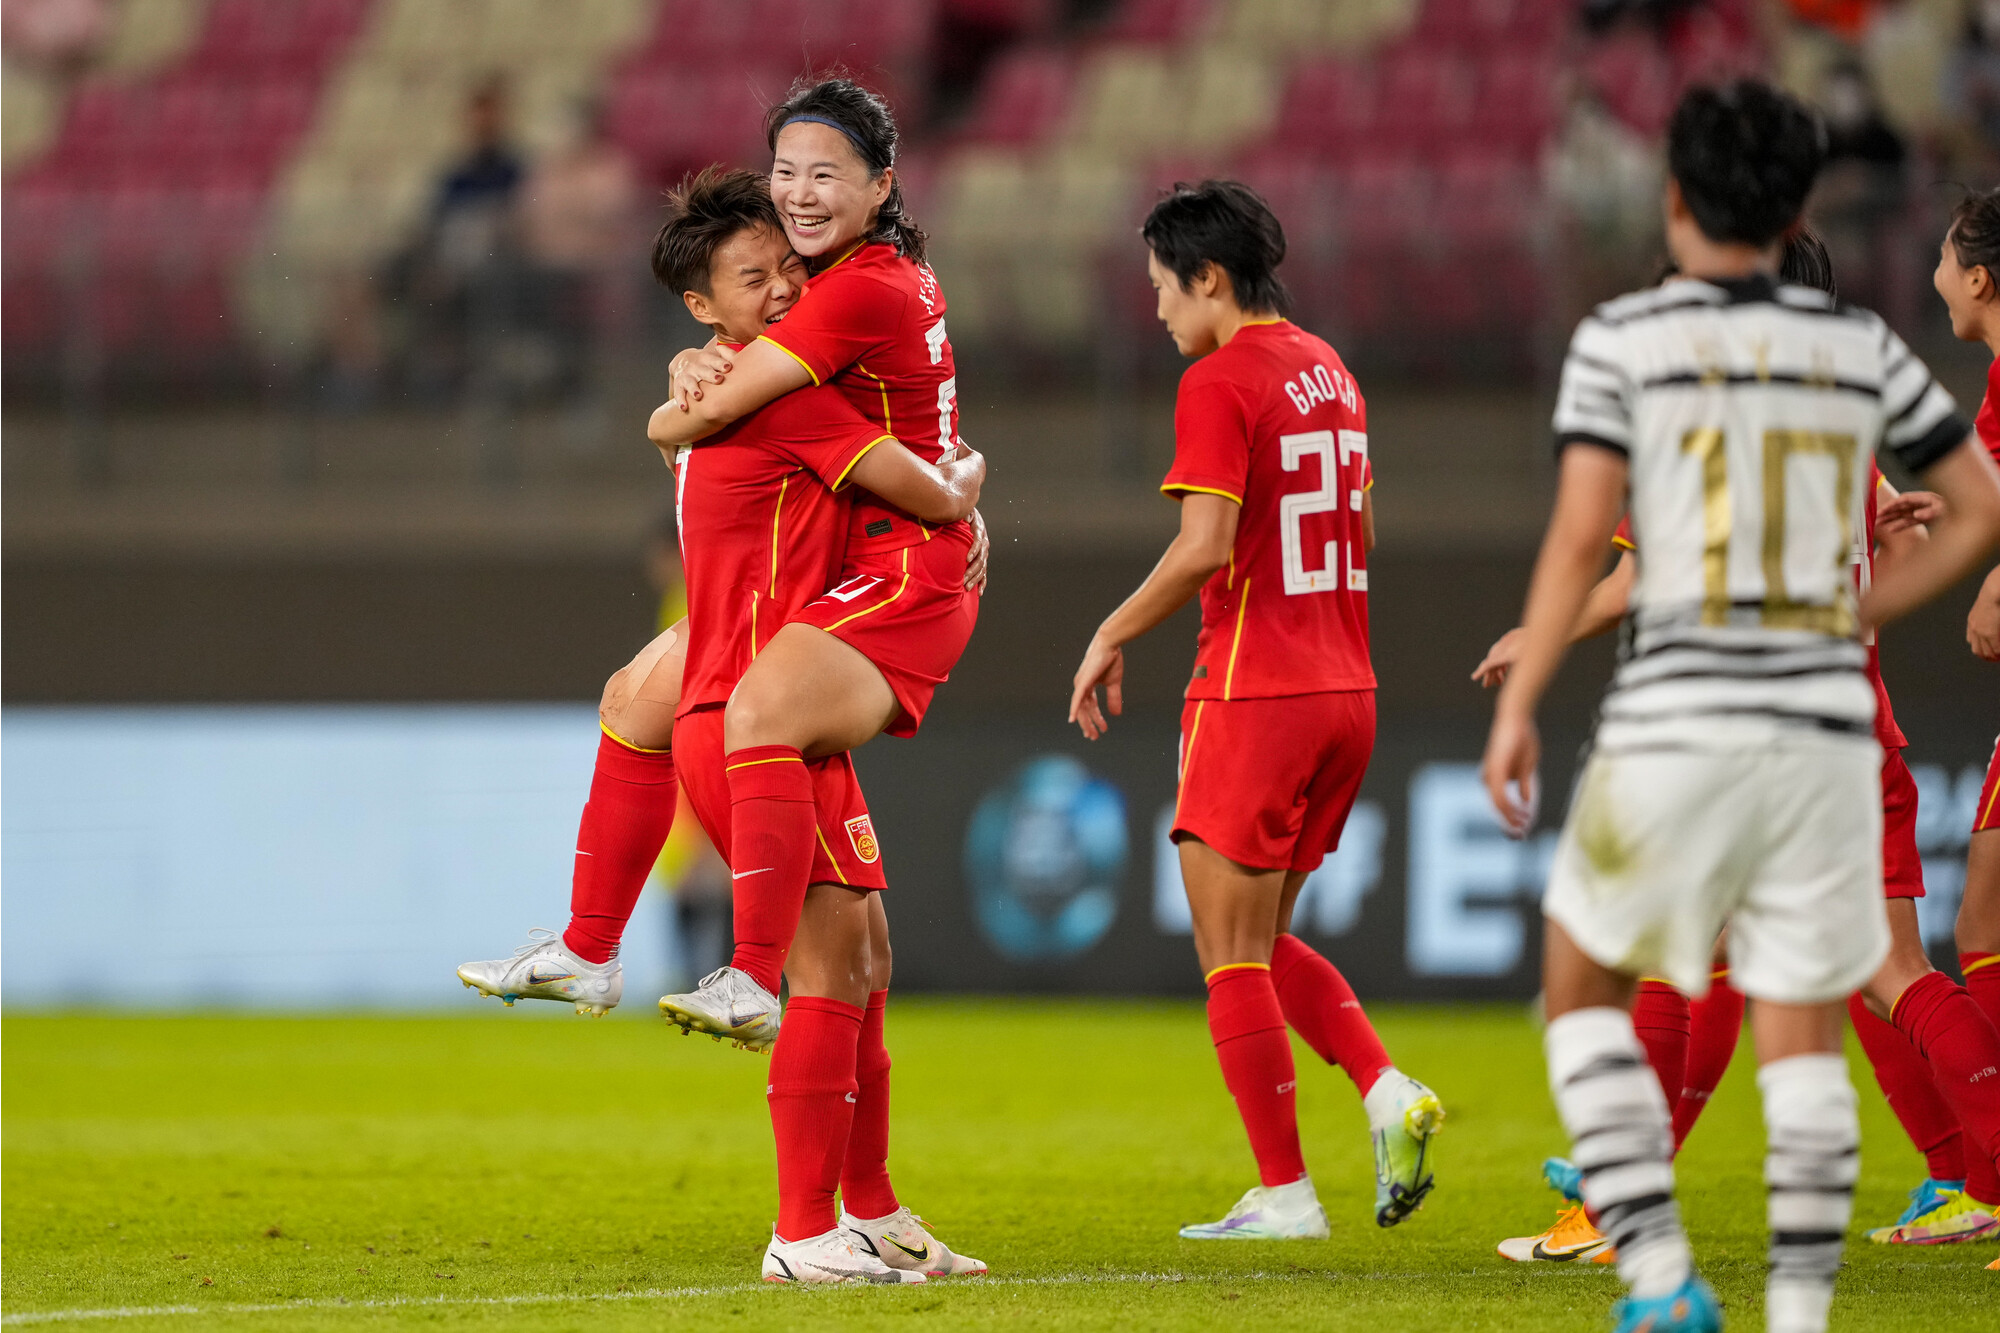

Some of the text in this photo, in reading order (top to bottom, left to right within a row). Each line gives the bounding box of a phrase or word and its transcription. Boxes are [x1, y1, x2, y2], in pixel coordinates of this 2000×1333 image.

[1284, 364, 1337, 416] GAO
[1280, 429, 1368, 596] 23
[1680, 427, 1857, 638] 10
[850, 820, 869, 832] CFA
[1970, 1066, 1997, 1083] 中国
